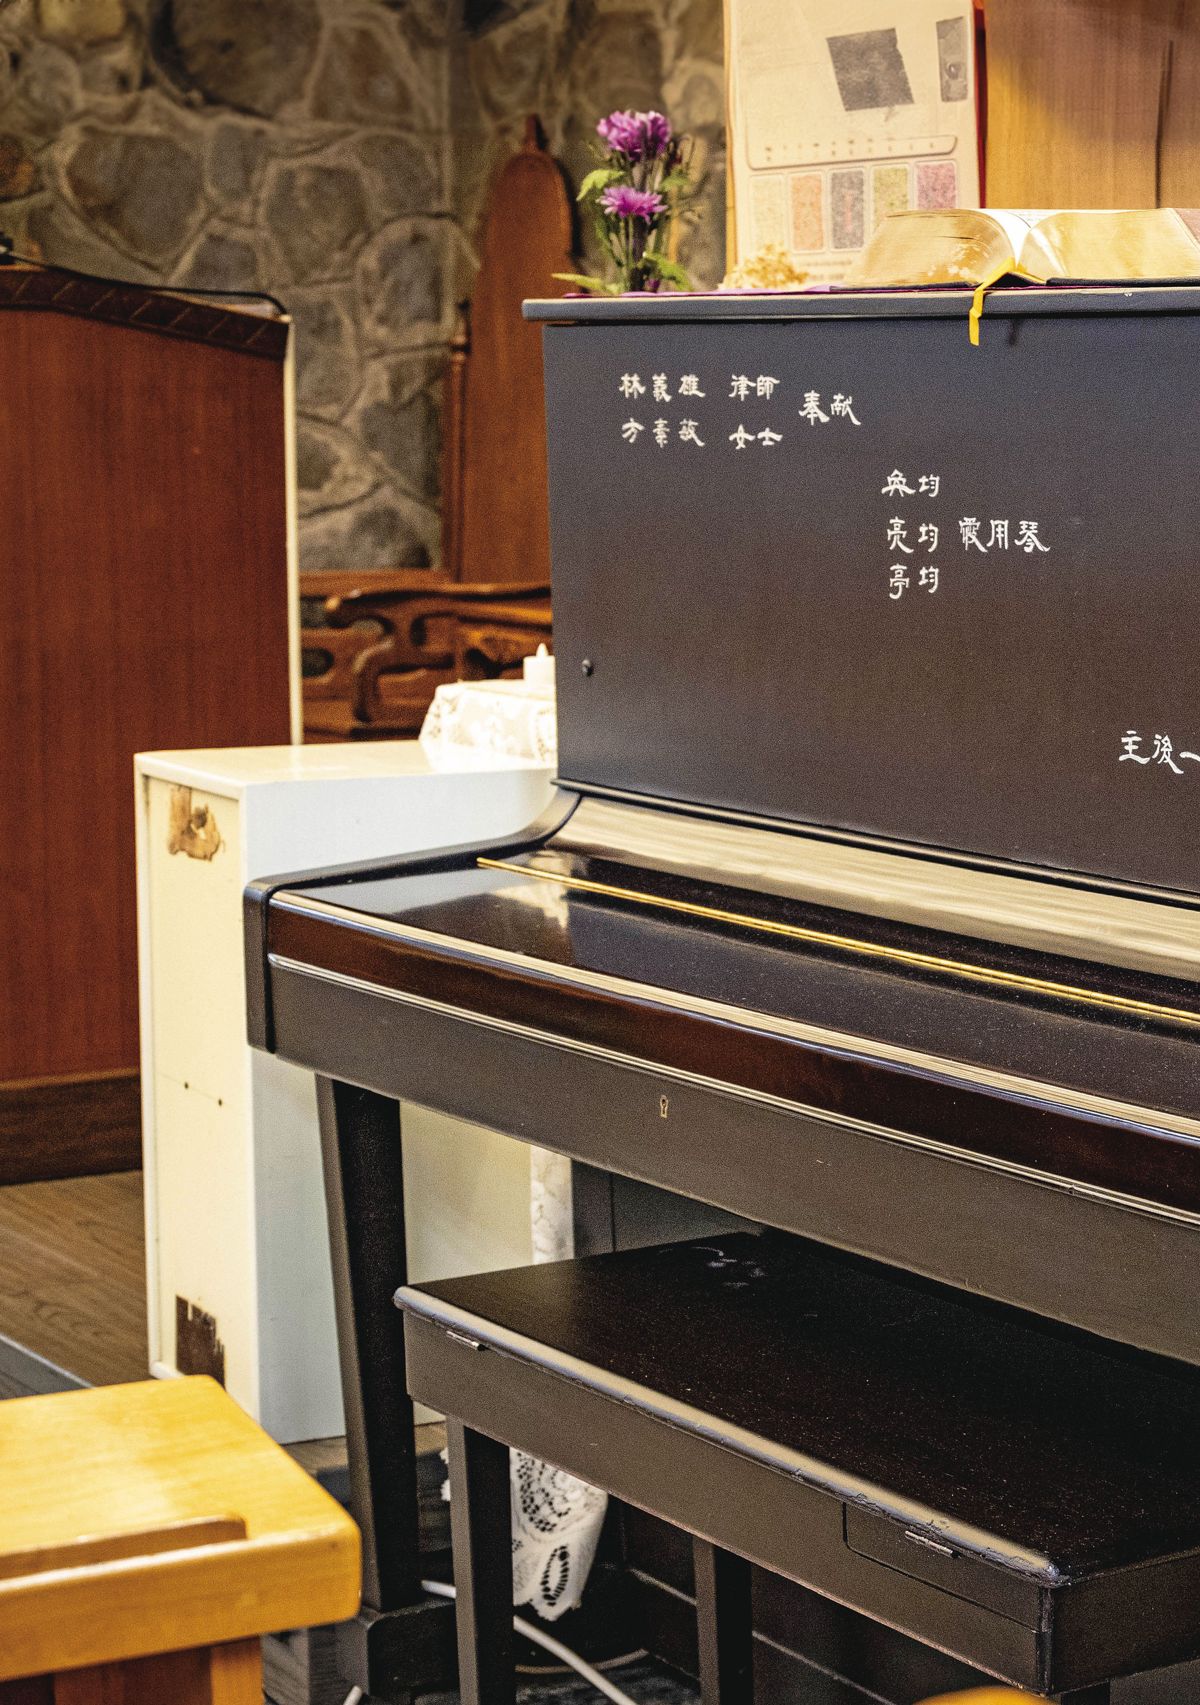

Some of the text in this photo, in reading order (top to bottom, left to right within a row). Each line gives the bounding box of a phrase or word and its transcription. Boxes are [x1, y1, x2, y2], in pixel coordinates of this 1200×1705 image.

[619, 373, 780, 402] 林義雄 律師
[729, 424, 783, 449] 女士
[887, 516, 939, 554] 亮均
[889, 563, 939, 599] 亭均
